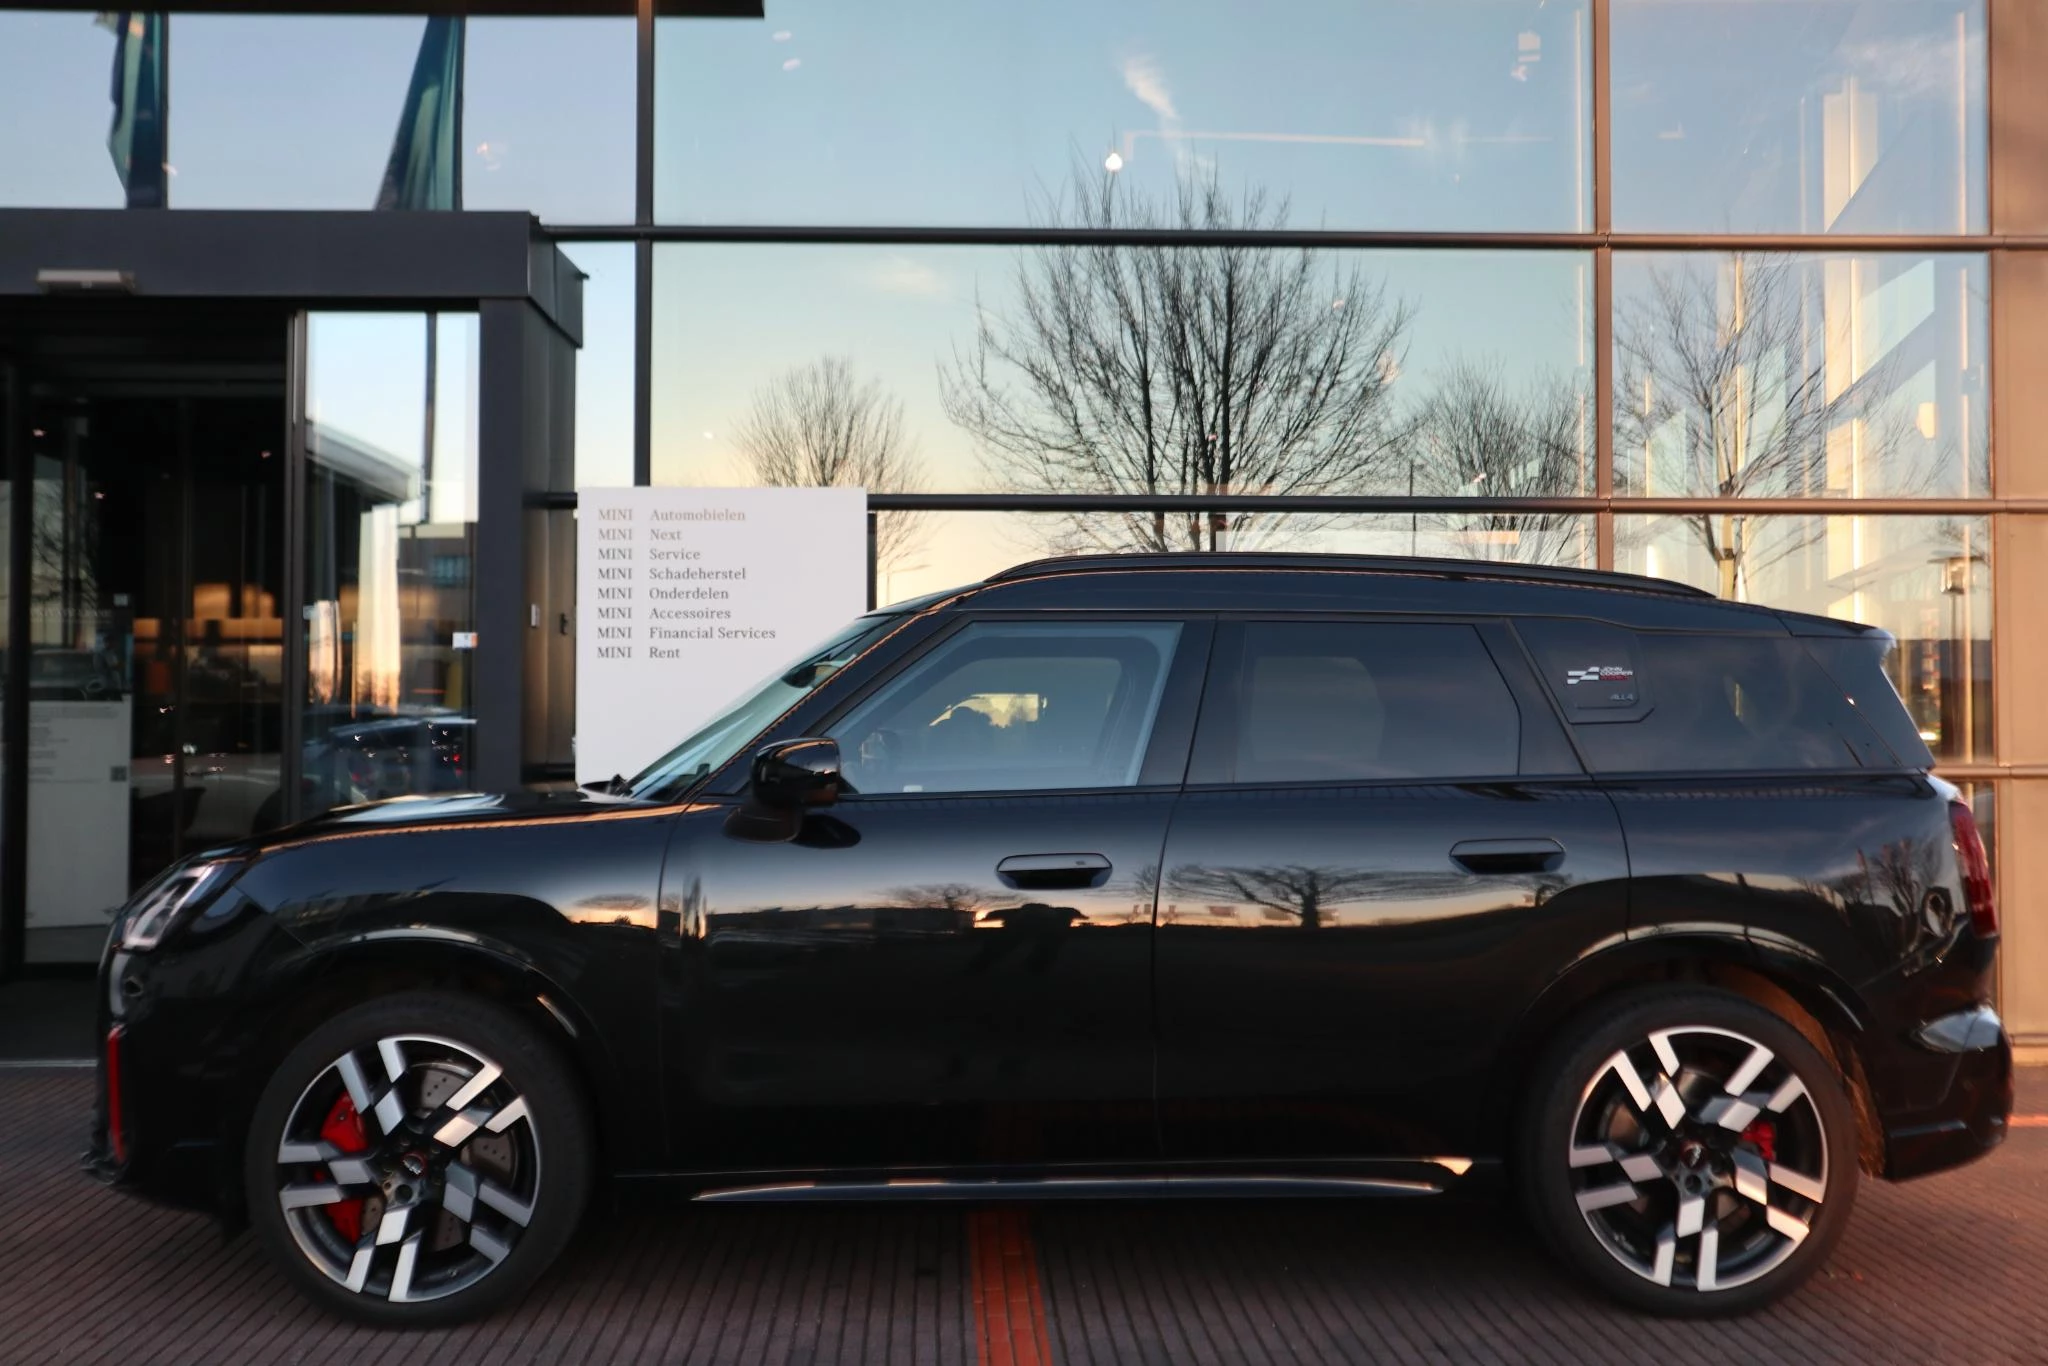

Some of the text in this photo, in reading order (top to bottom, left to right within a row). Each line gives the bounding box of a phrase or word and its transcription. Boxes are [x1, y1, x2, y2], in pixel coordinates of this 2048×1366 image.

[598, 508, 746, 521] MINI Automobielen
[598, 527, 682, 540] MINI Next
[597, 547, 701, 560] MINI Service
[597, 566, 747, 580] MINI Schadeherstel
[597, 586, 730, 600] MINI Onderdelen
[597, 606, 732, 619] MINI Accessoires
[596, 625, 777, 640] MINI Financial Services
[596, 645, 681, 659] MINI Rent
